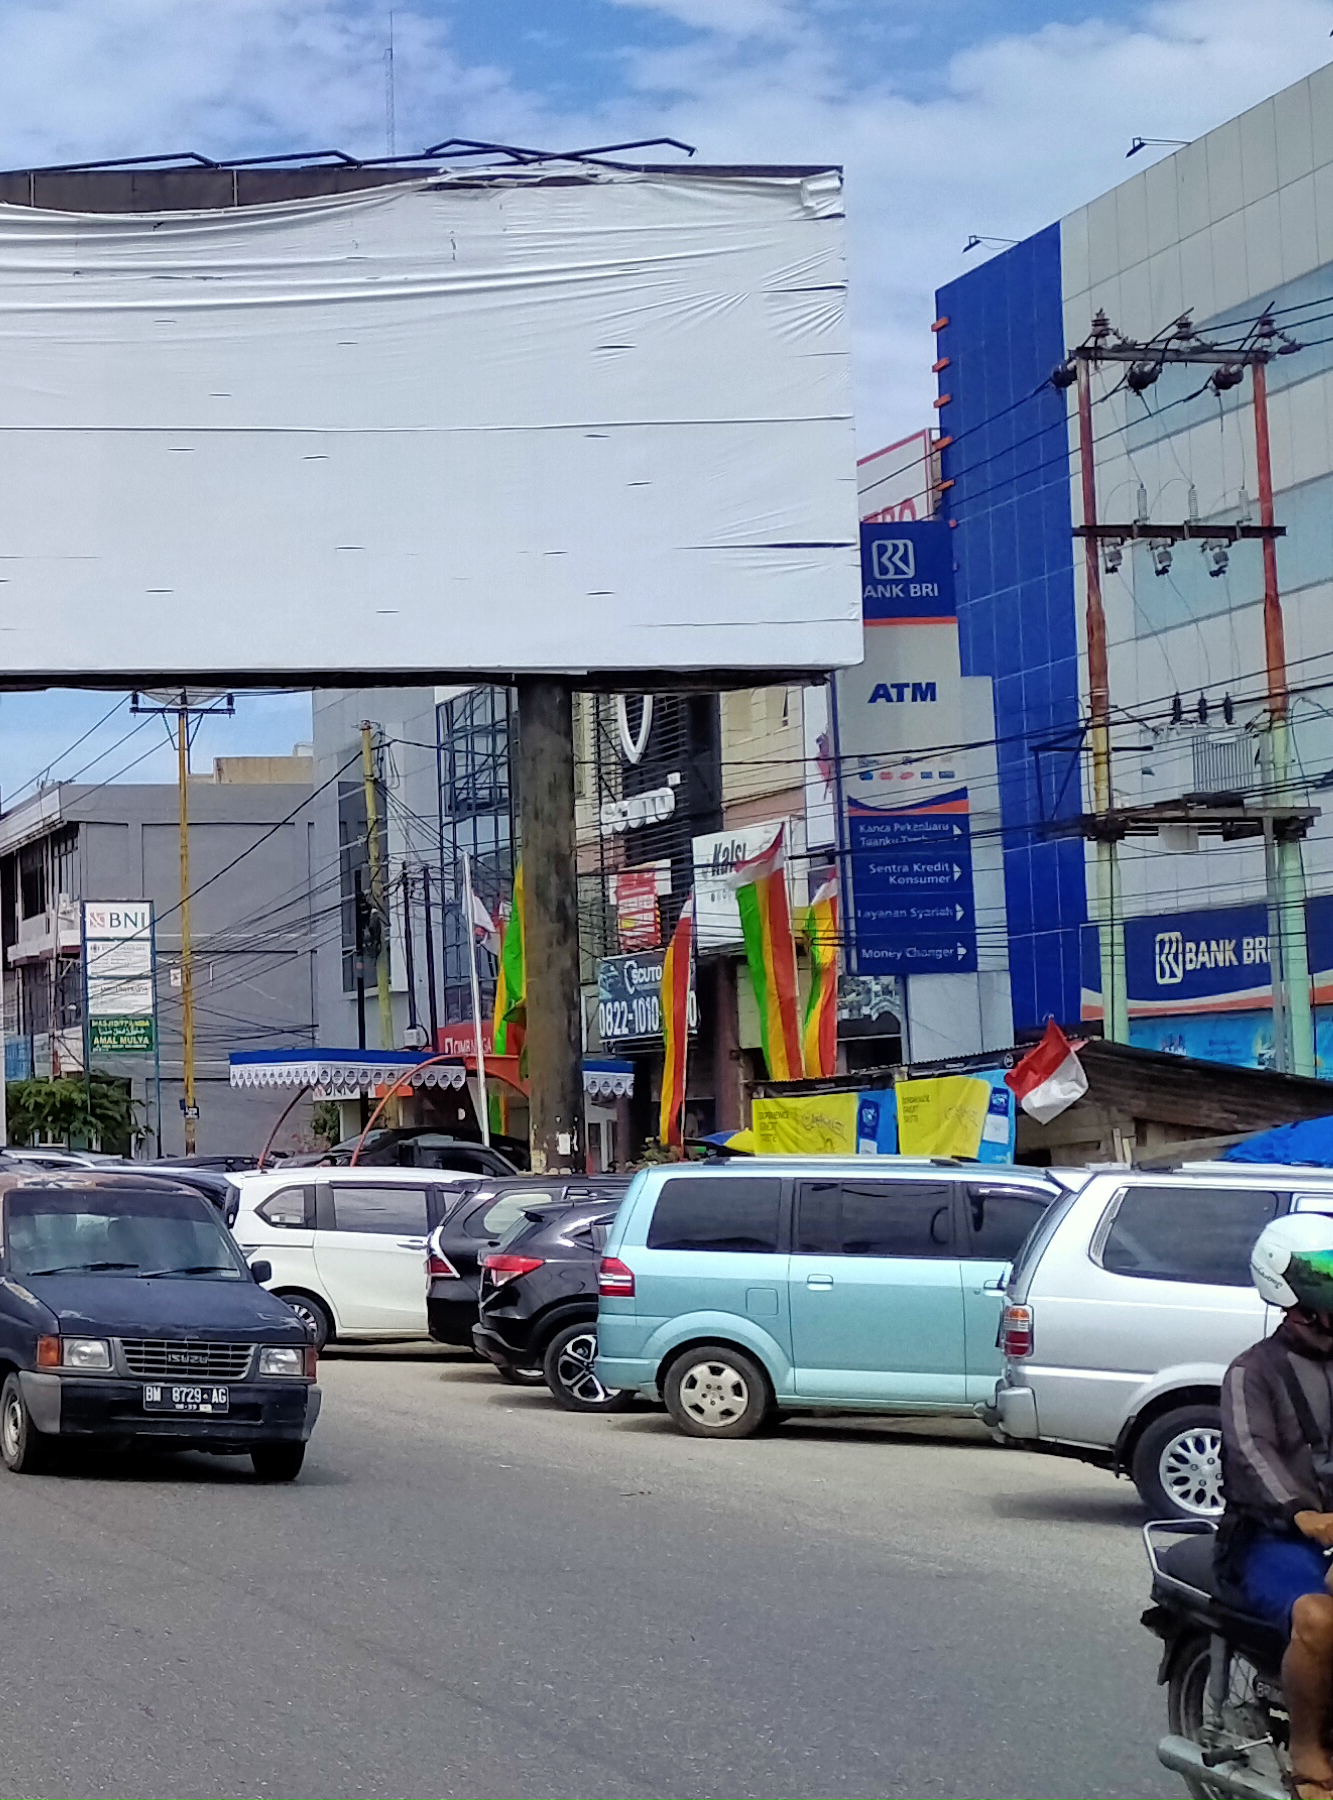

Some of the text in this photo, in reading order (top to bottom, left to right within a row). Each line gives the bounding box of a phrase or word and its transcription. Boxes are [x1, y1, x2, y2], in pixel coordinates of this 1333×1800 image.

[863, 583, 938, 598] ANK BRI
[868, 682, 936, 703] ATM
[870, 861, 949, 874] Sentra Kredit
[889, 874, 951, 885] Konsumer
[110, 912, 146, 928] BNI
[861, 948, 902, 960] Money
[1185, 939, 1238, 970] BANK
[167, 1354, 208, 1364] ISUZU
[146, 1386, 226, 1404] BM 8729 AG
